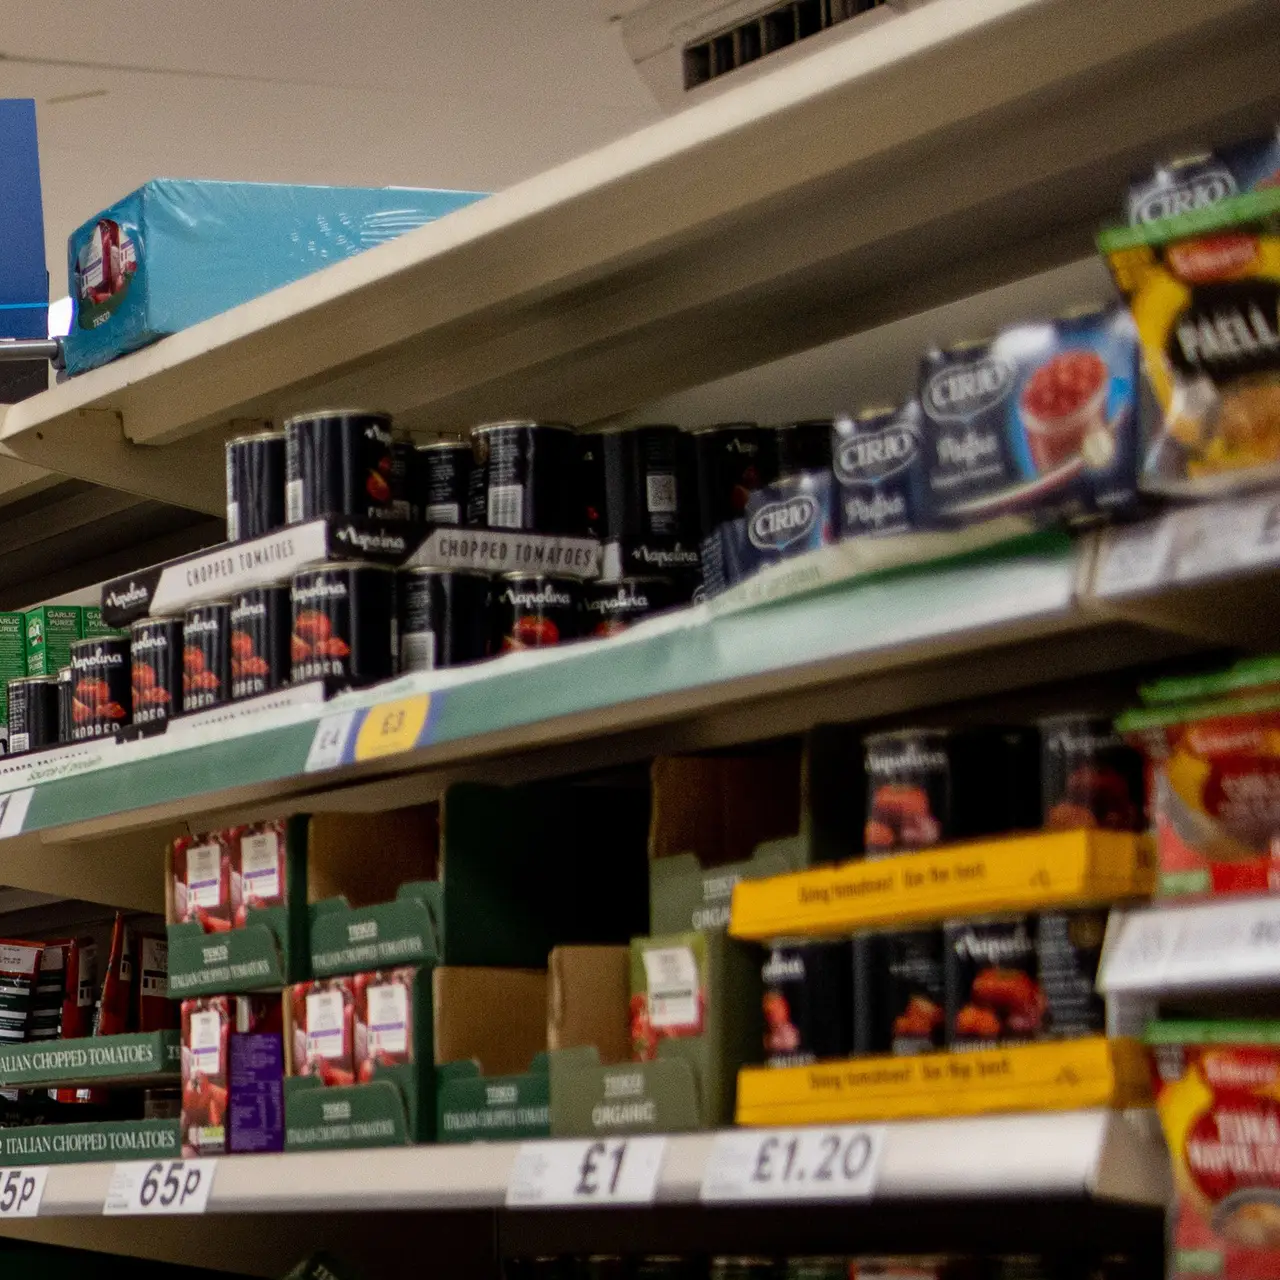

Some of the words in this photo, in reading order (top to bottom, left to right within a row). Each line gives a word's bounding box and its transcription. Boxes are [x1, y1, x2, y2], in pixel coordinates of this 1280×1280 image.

[92, 311, 110, 328] TESCO
[186, 561, 234, 587] CHOPPED
[240, 539, 294, 570] TOMATOES
[439, 539, 507, 560] CHOPPED
[515, 544, 591, 567] TOMATOES
[47, 611, 77, 619] GARLIC
[49, 618, 75, 626] PUREE
[33, 1050, 86, 1070] CHOPPED
[90, 1044, 153, 1065] TOMATOES
[6, 1136, 51, 1154] ITALIAN
[53, 1134, 107, 1152] CHOPPED
[109, 1131, 175, 1149] TOMATOES
[573, 1140, 627, 1195] £1
[750, 1132, 873, 1184] £1.20
[140, 1163, 201, 1206] 65p
